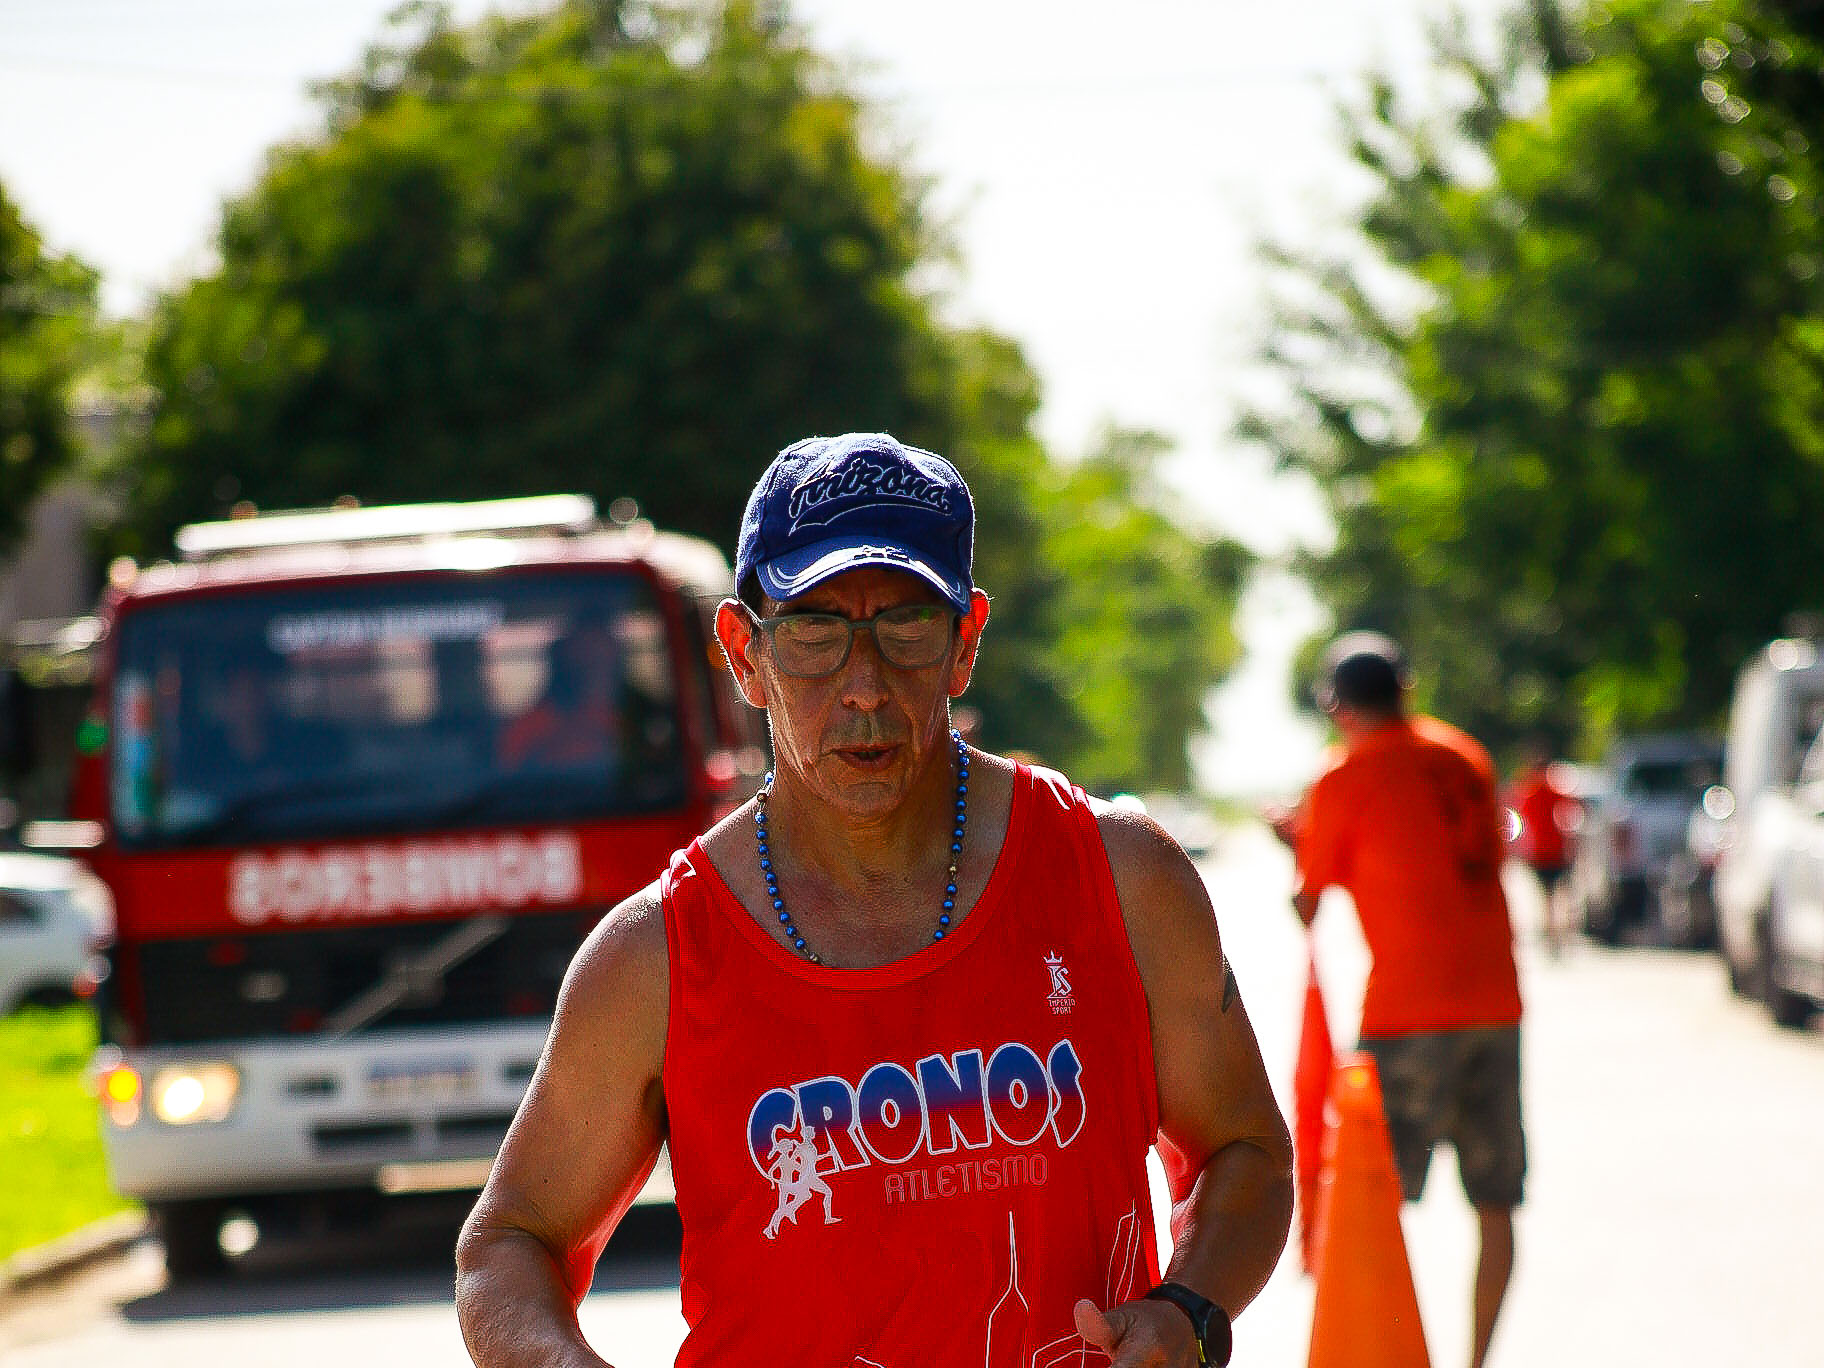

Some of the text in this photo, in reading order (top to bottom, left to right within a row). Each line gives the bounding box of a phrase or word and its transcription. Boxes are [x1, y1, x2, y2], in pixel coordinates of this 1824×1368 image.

[1051, 1006, 1072, 1015] SPORT
[747, 1038, 1086, 1178] CRONOS
[884, 1153, 1048, 1204] ATLETISMO
